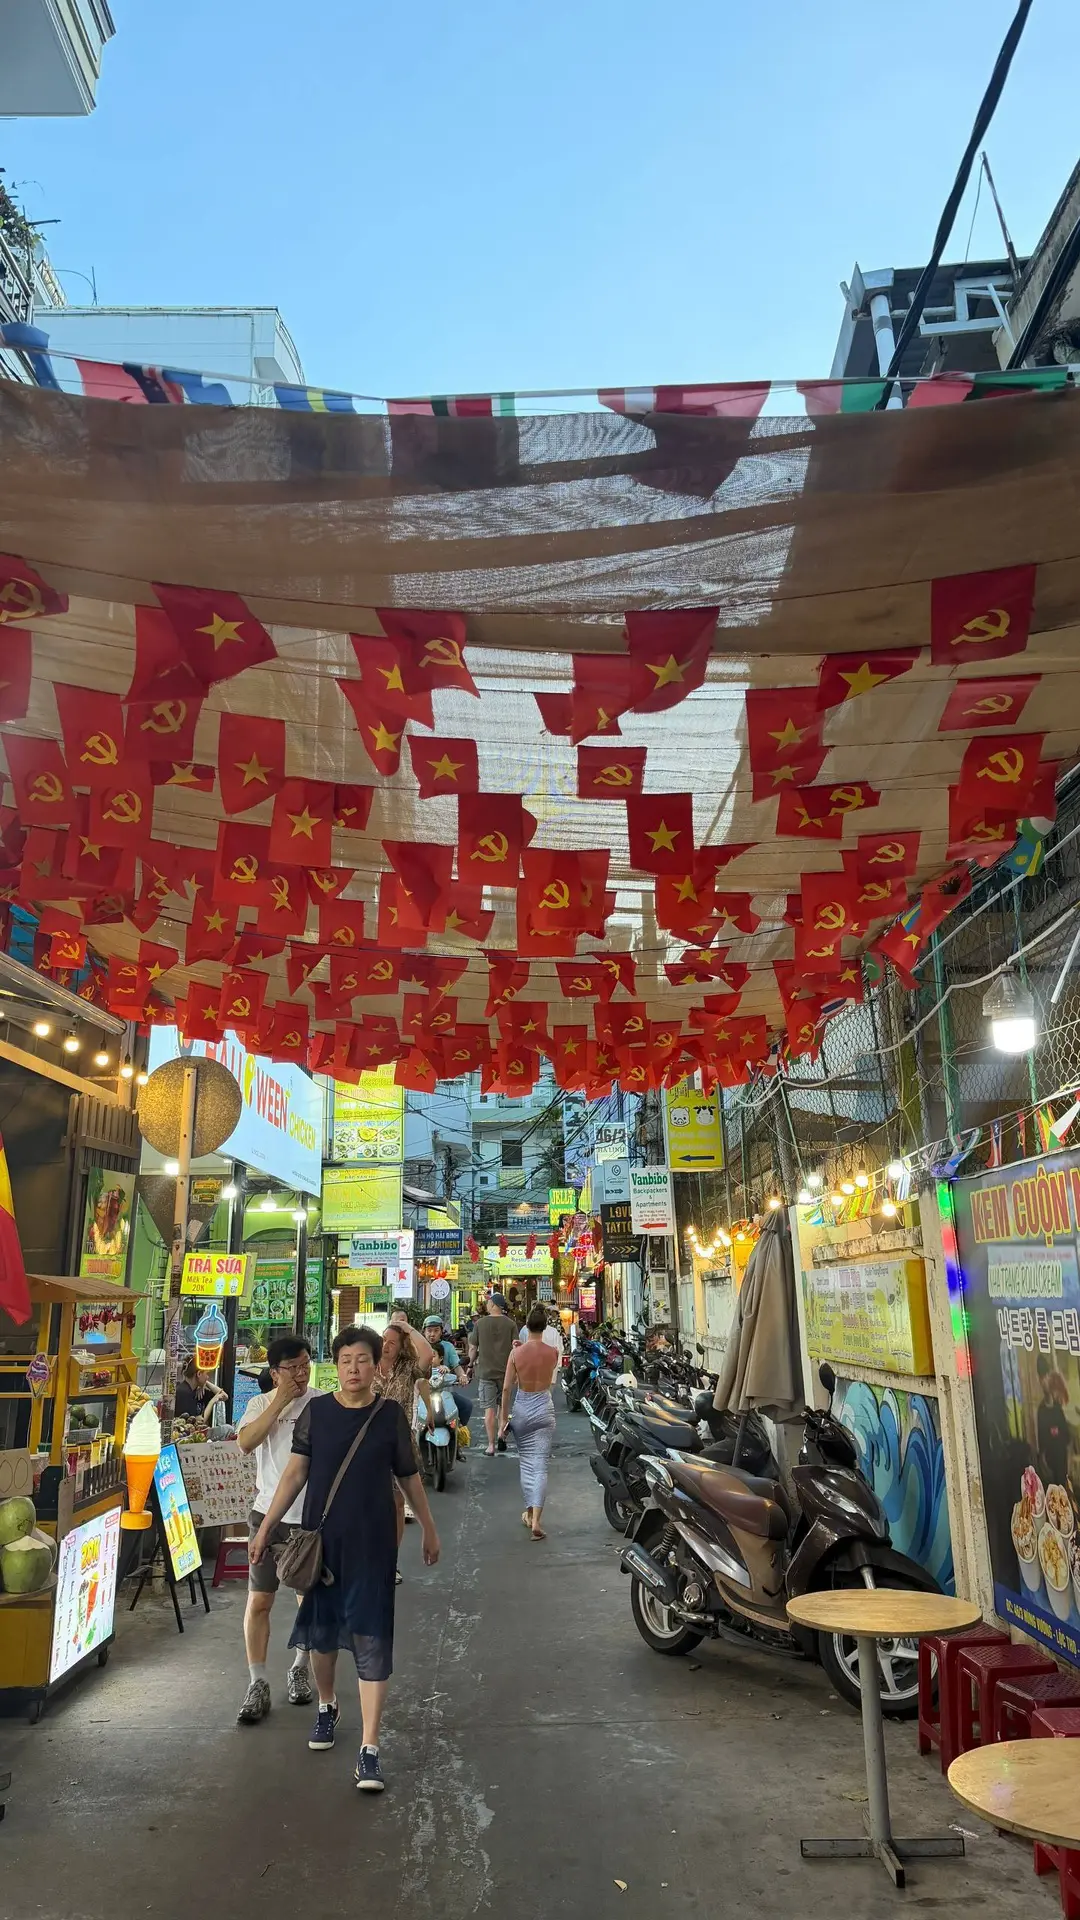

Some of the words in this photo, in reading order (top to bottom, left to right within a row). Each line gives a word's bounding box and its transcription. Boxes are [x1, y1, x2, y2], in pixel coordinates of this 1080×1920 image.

[289, 1112, 316, 1151] CHICKEN
[631, 1172, 668, 1186] Vanbibo
[551, 1189, 575, 1205] JELLY
[970, 1185, 1013, 1243] KEM
[1012, 1164, 1072, 1248] CUỘN
[606, 1221, 632, 1234] TATTO
[352, 1240, 398, 1251] Vanbibo
[187, 1276, 201, 1284] Milk
[202, 1276, 213, 1284] Tea
[1038, 1260, 1062, 1296] CREAM
[192, 1284, 205, 1292] 20K
[998, 1307, 1034, 1351] 나트랑
[1035, 1308, 1050, 1353] 롤
[1052, 1308, 1080, 1356] 크림
